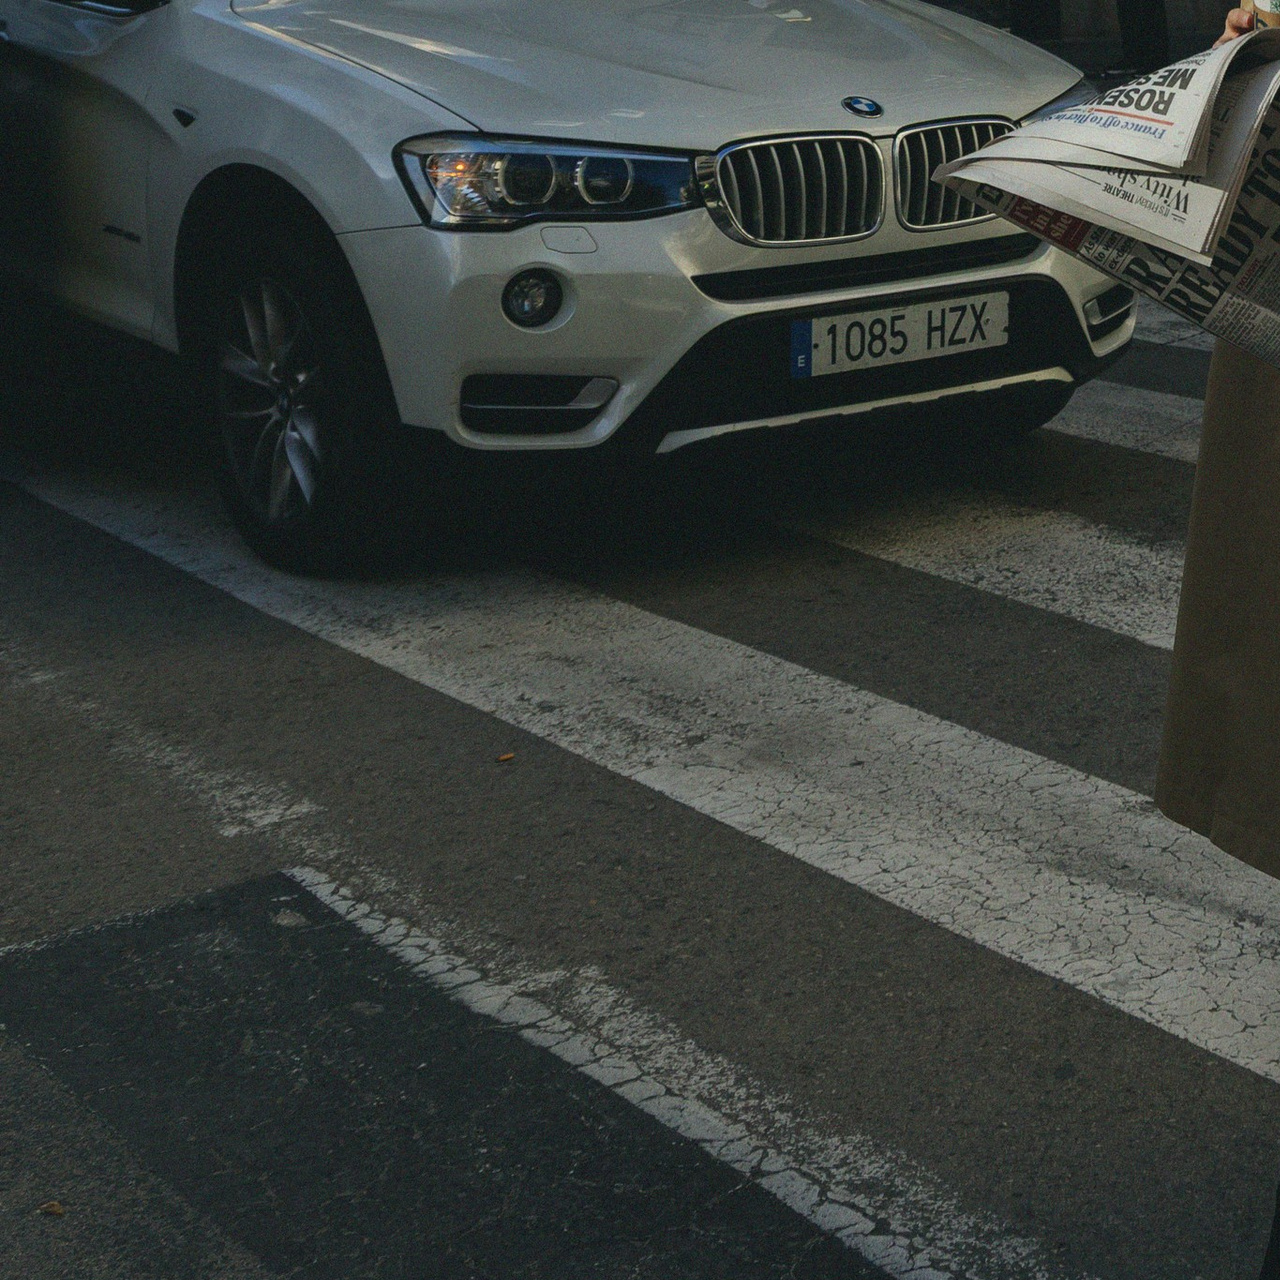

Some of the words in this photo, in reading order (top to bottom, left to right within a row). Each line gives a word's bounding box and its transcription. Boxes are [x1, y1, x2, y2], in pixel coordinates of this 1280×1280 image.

[1101, 115, 1120, 129] off
[1120, 120, 1167, 140] France
[1101, 182, 1134, 203] THEATRE
[1140, 174, 1190, 214] Witty
[1164, 198, 1277, 325] READY
[827, 314, 908, 365] 1085
[927, 301, 988, 350] HZX
[797, 354, 806, 368] E
